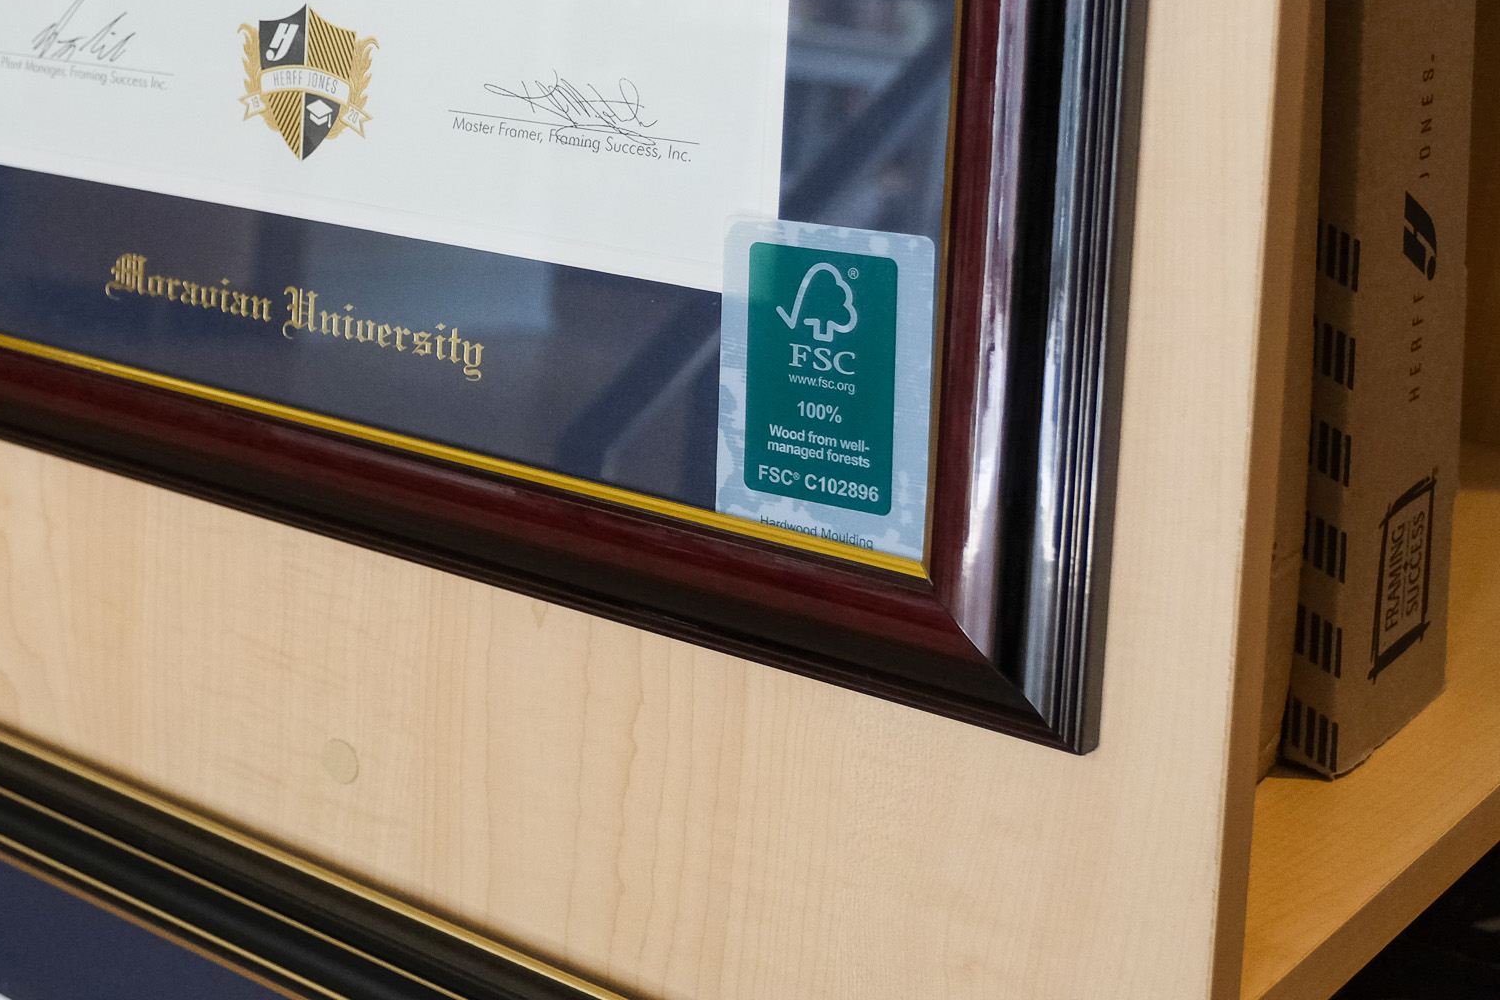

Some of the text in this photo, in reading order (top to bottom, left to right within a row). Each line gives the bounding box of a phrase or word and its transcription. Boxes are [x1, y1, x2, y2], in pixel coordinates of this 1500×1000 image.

[1, 56, 24, 70] Plant
[69, 66, 108, 86] Framing
[109, 71, 148, 88] Success
[150, 76, 167, 91] Inc.
[273, 70, 338, 95] HERFF JONES
[347, 108, 360, 124] 20
[452, 116, 692, 163] Master Framer, Framing Success, Inc.
[1408, 291, 1425, 402] HERFF
[1419, 67, 1435, 180] JONES
[105, 253, 485, 382] Moravian University
[788, 343, 856, 375] FSC
[788, 373, 856, 395] www.fsc.org
[797, 400, 842, 424] 100%
[767, 439, 871, 469] managed forests
[769, 424, 870, 453] Wood from well-
[804, 473, 880, 503] C102896
[760, 515, 874, 551] Hardwood Moulding
[1385, 522, 1405, 632] FRAMING
[1406, 510, 1425, 617] SUCCESS
